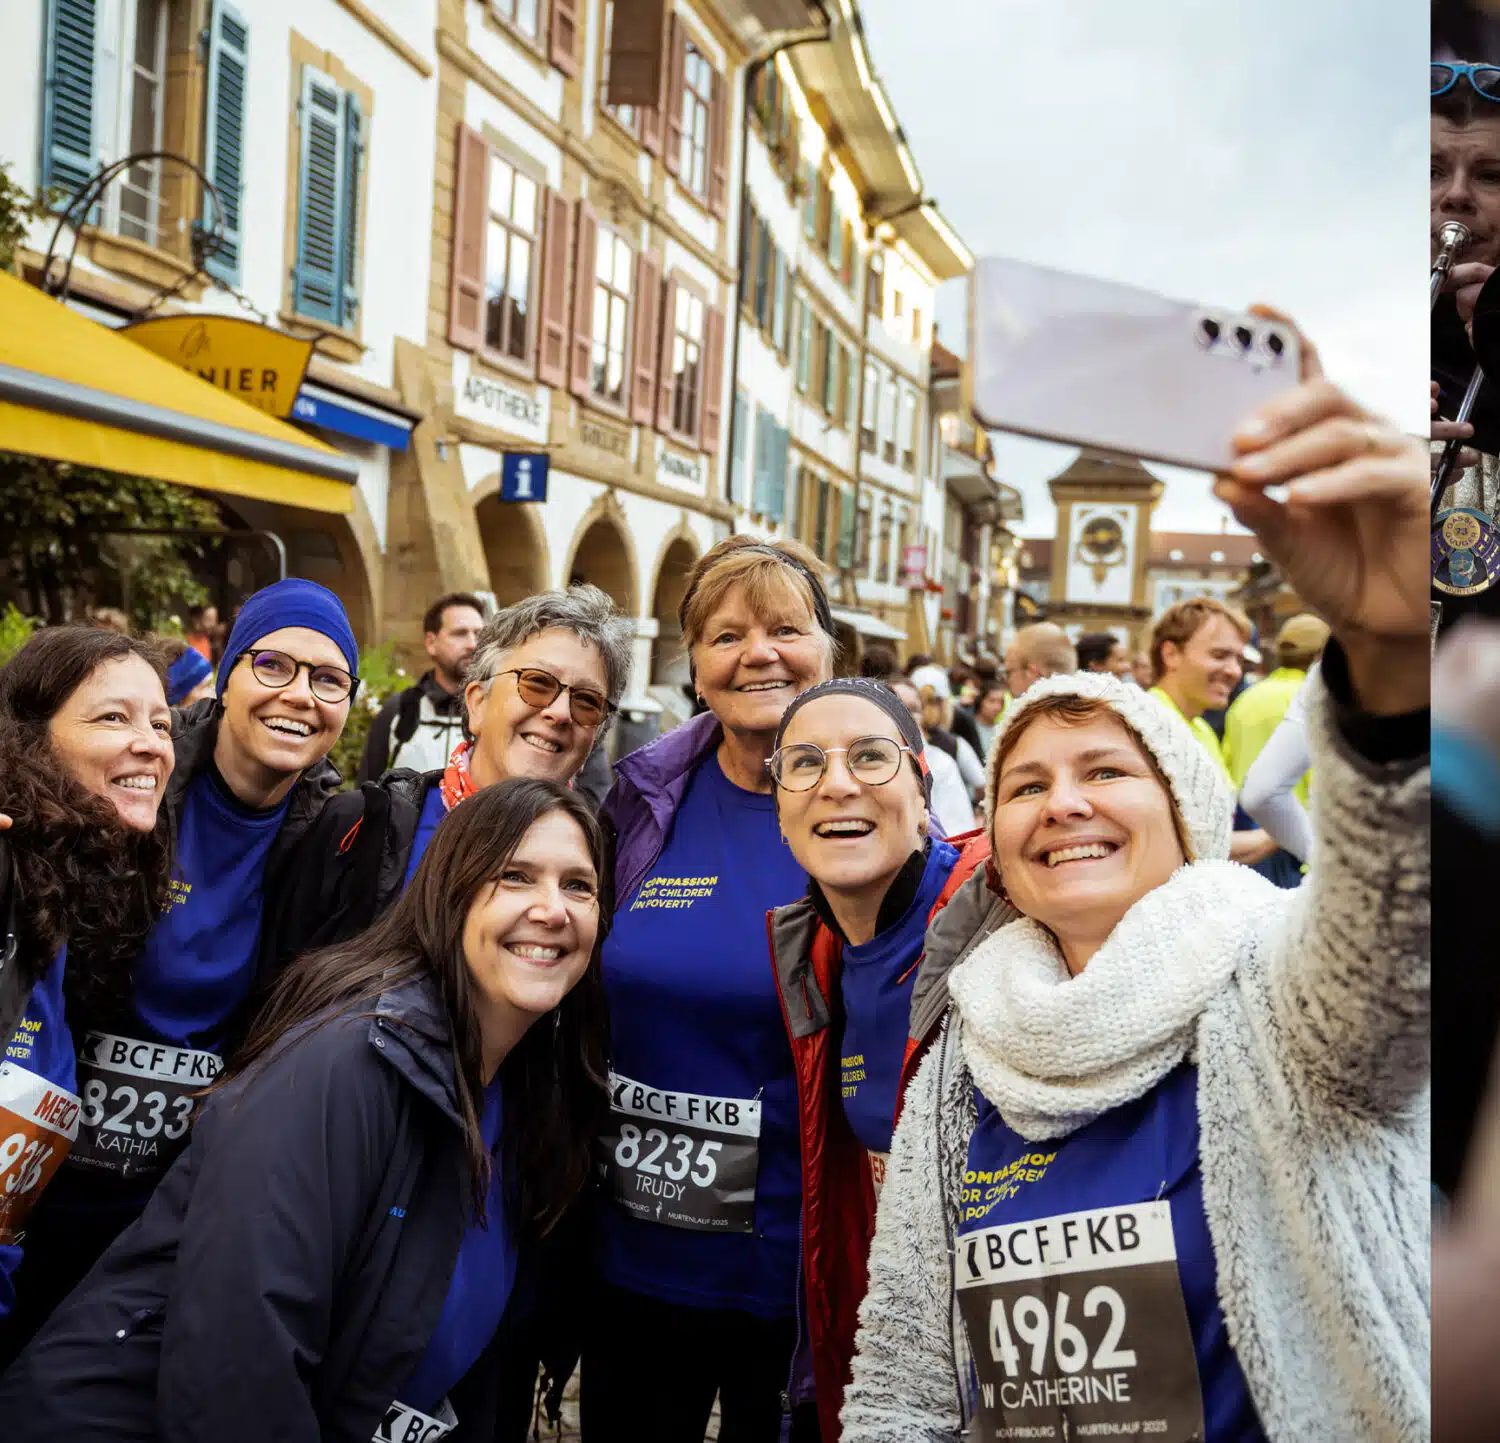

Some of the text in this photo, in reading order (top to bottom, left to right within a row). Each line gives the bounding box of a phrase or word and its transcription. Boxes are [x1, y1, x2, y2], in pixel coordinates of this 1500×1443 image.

[464, 377, 543, 427] APOTHEKE
[640, 887, 713, 899] FOR CHILDREN
[645, 876, 718, 889] COMPASSION
[646, 899, 694, 909] POVERTY
[79, 1079, 195, 1140] 8233
[95, 1132, 159, 1157] KATHIA
[615, 1123, 723, 1188] 8235
[635, 1173, 686, 1202] TRUDY
[667, 1212, 711, 1226] MURTENLAUF
[711, 1218, 729, 1227] 2025
[989, 1285, 1137, 1378] 4962
[1000, 1373, 1131, 1409] CATHERINE
[1076, 1421, 1141, 1437] MURTENLAUF
[1141, 1419, 1168, 1434] 2025
